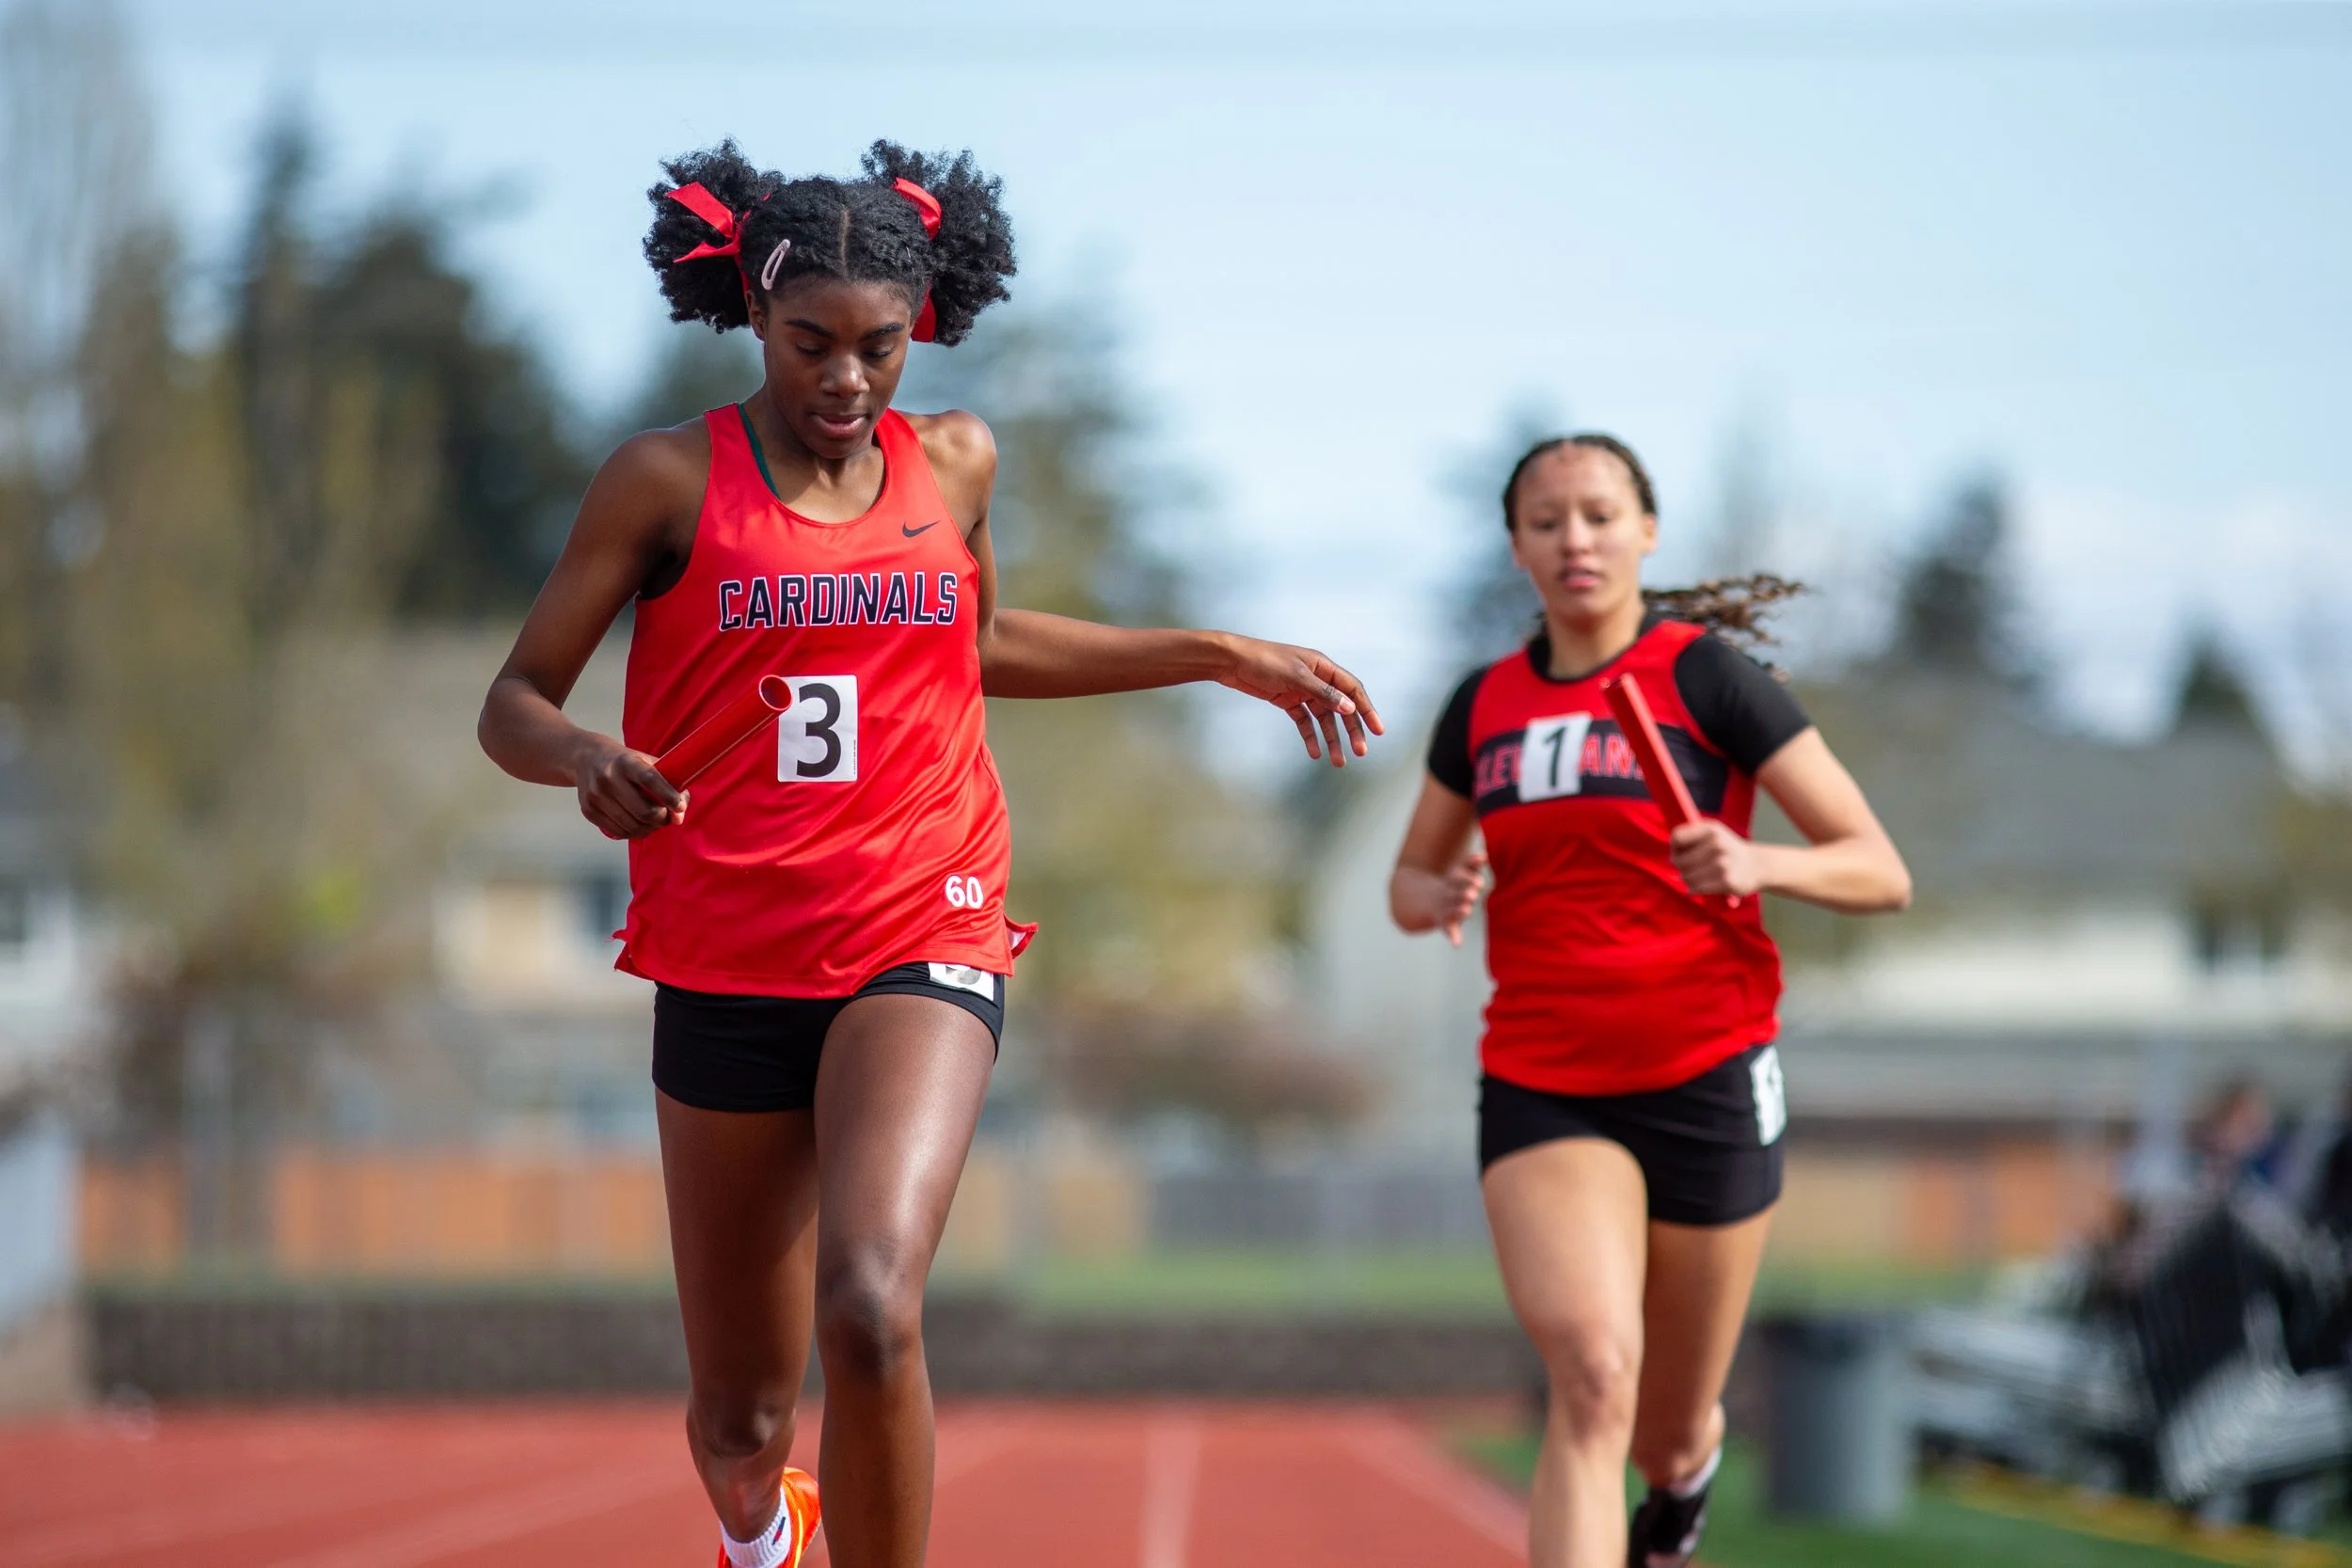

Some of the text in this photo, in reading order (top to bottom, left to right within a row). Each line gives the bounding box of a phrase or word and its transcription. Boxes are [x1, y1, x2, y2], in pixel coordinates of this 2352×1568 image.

[719, 571, 958, 632] CARDINALS
[796, 682, 842, 778] 3
[1543, 725, 1566, 789] 1
[945, 875, 984, 910] 60
